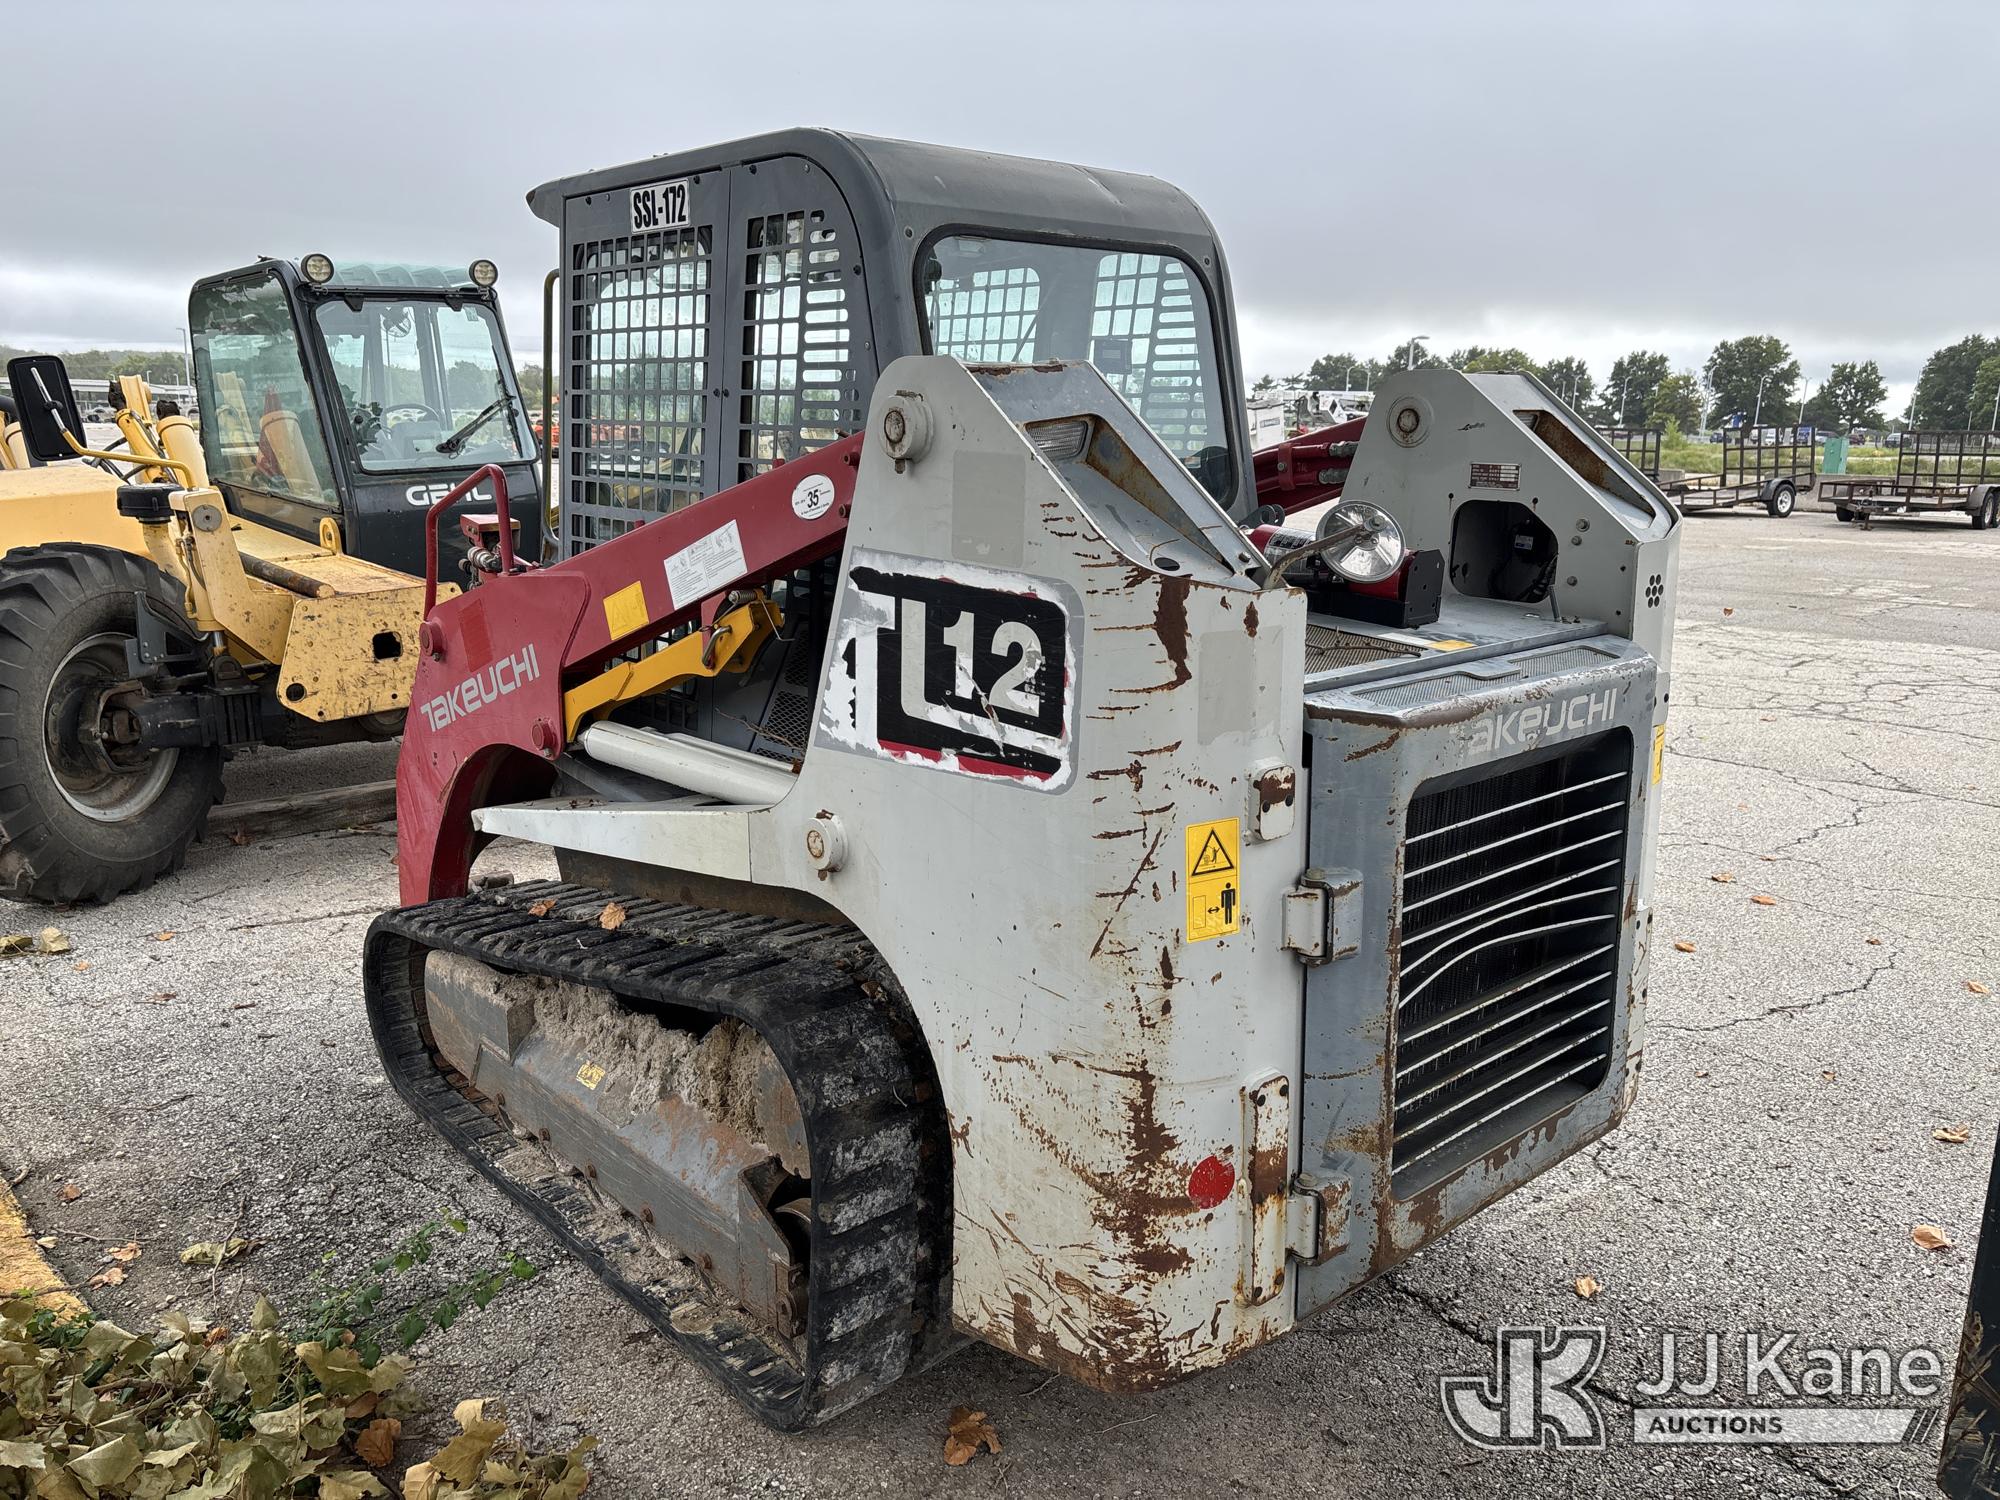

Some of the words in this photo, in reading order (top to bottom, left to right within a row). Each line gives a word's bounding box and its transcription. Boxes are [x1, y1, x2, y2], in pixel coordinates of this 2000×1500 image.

[633, 184, 687, 229] SSL-172
[406, 483, 492, 506] GEL
[807, 489, 819, 508] 35
